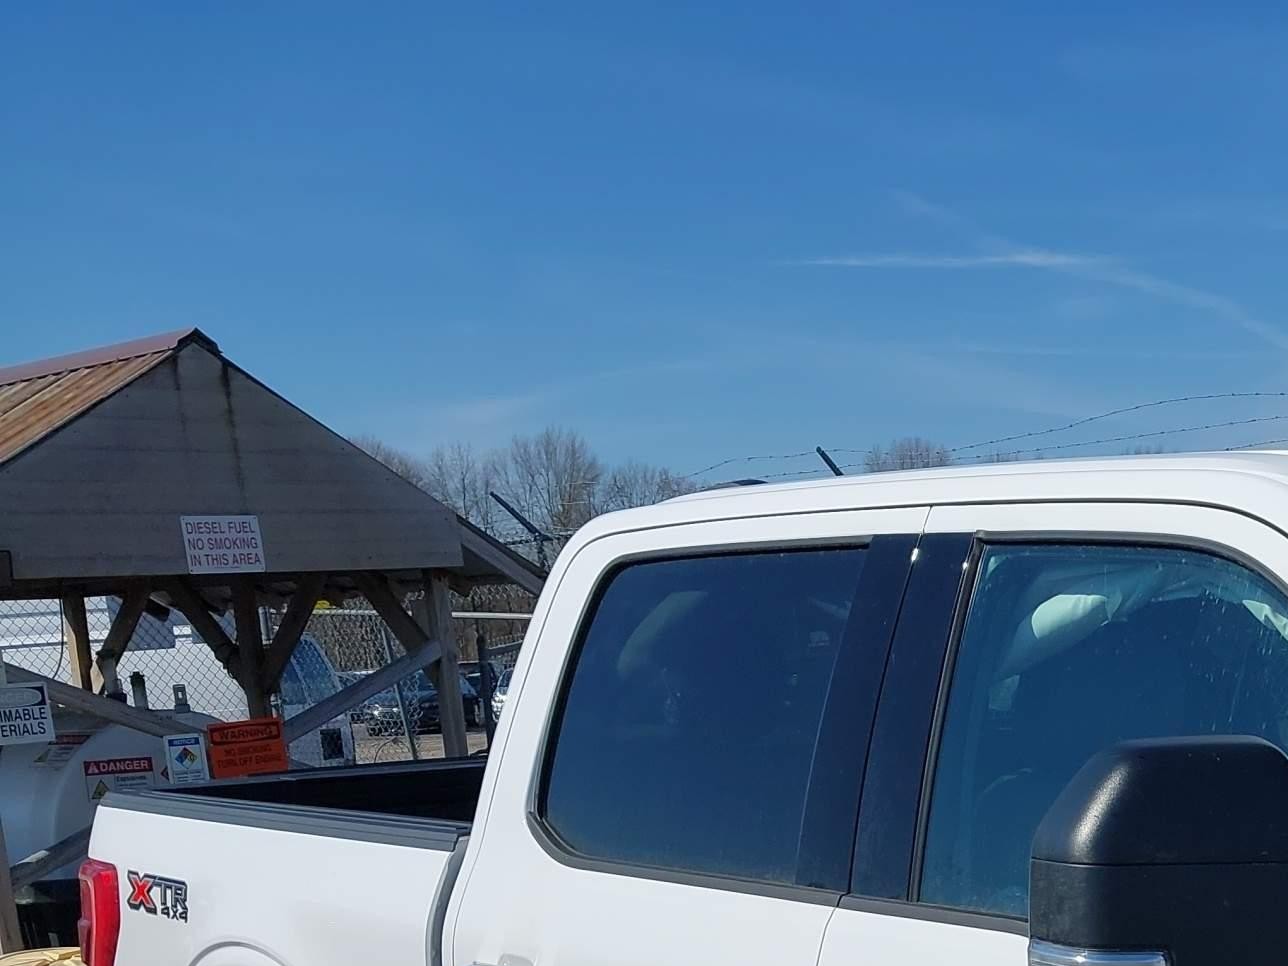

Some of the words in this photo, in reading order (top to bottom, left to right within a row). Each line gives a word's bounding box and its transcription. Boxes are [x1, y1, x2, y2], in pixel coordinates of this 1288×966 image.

[185, 521, 225, 534] DIESEL
[227, 520, 256, 534] FUEL
[187, 538, 204, 550] NO
[207, 537, 258, 550] SMOKING
[190, 554, 202, 567] IN
[203, 553, 229, 566] THIS
[232, 552, 261, 565] AREA
[1, 722, 46, 737] ERIALS
[220, 726, 273, 739] WARNING
[100, 760, 149, 772] DANGER
[127, 870, 188, 916] XTR
